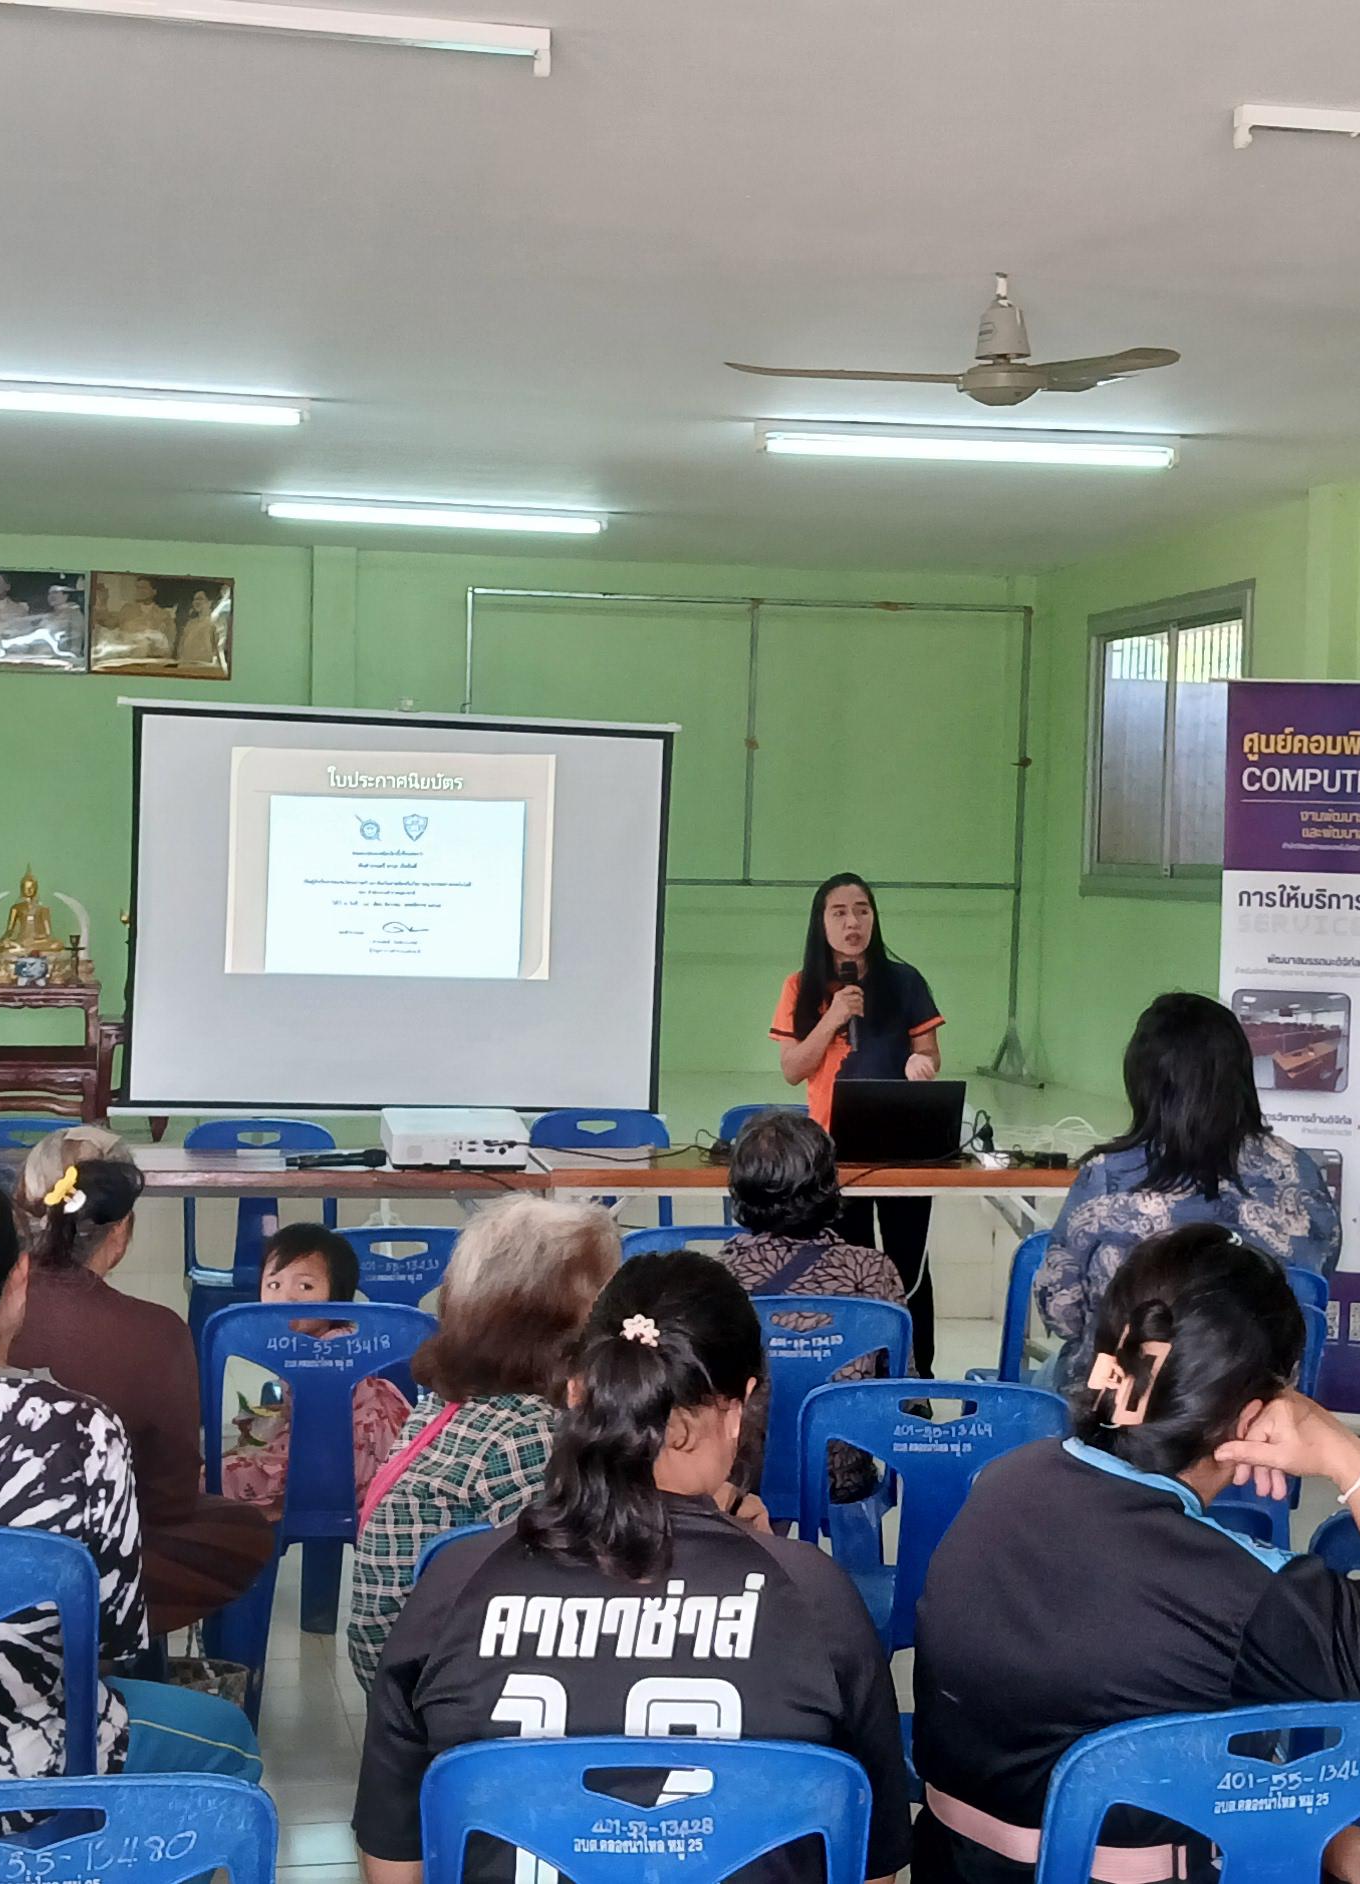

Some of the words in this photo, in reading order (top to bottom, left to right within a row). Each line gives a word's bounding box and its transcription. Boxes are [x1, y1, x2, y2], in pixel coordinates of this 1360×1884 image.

[266, 1334, 391, 1355] 401-55-13418
[1315, 1791, 1330, 1807] 25
[687, 1837, 704, 1853] 25
